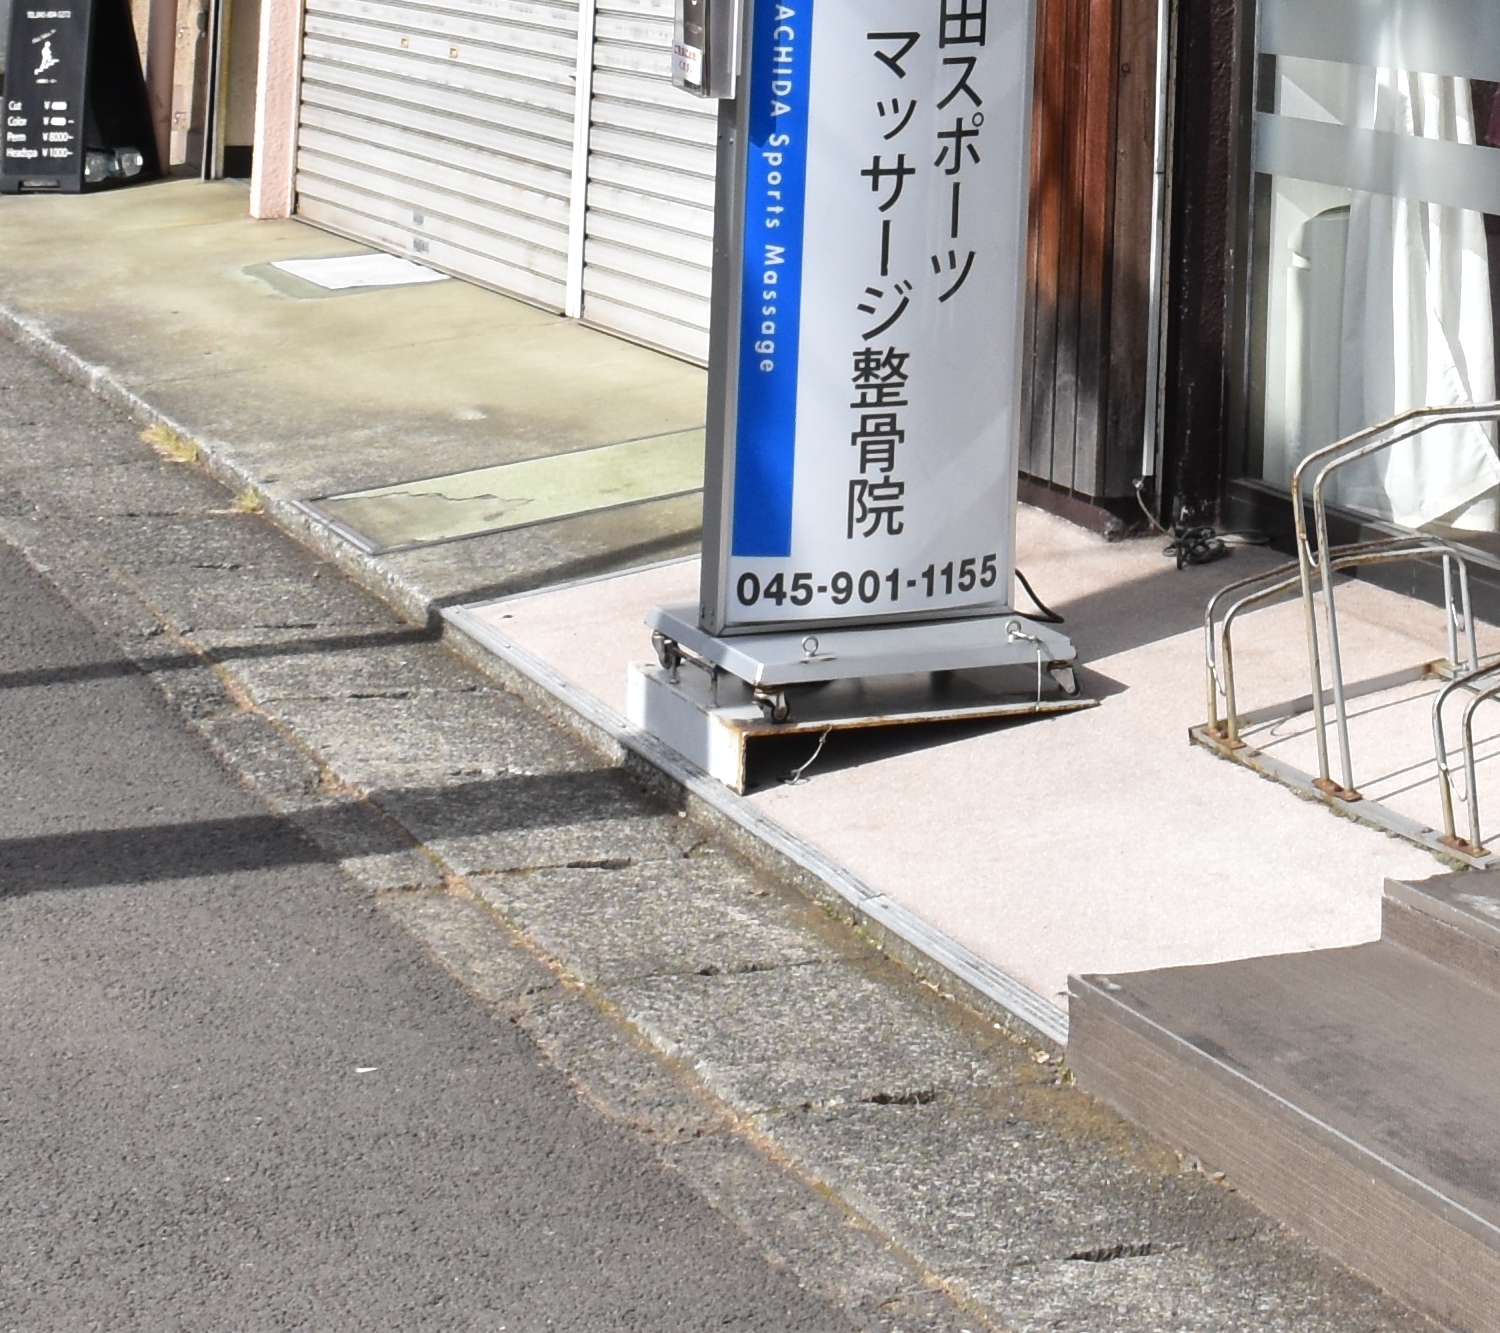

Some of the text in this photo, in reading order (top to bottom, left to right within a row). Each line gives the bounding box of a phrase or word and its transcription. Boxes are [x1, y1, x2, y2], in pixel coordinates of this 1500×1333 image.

[762, 132, 791, 231] Sports
[752, 242, 786, 375] Massage
[846, 27, 921, 540] マッサージ整骨院
[736, 552, 999, 609] 045-901-1155
